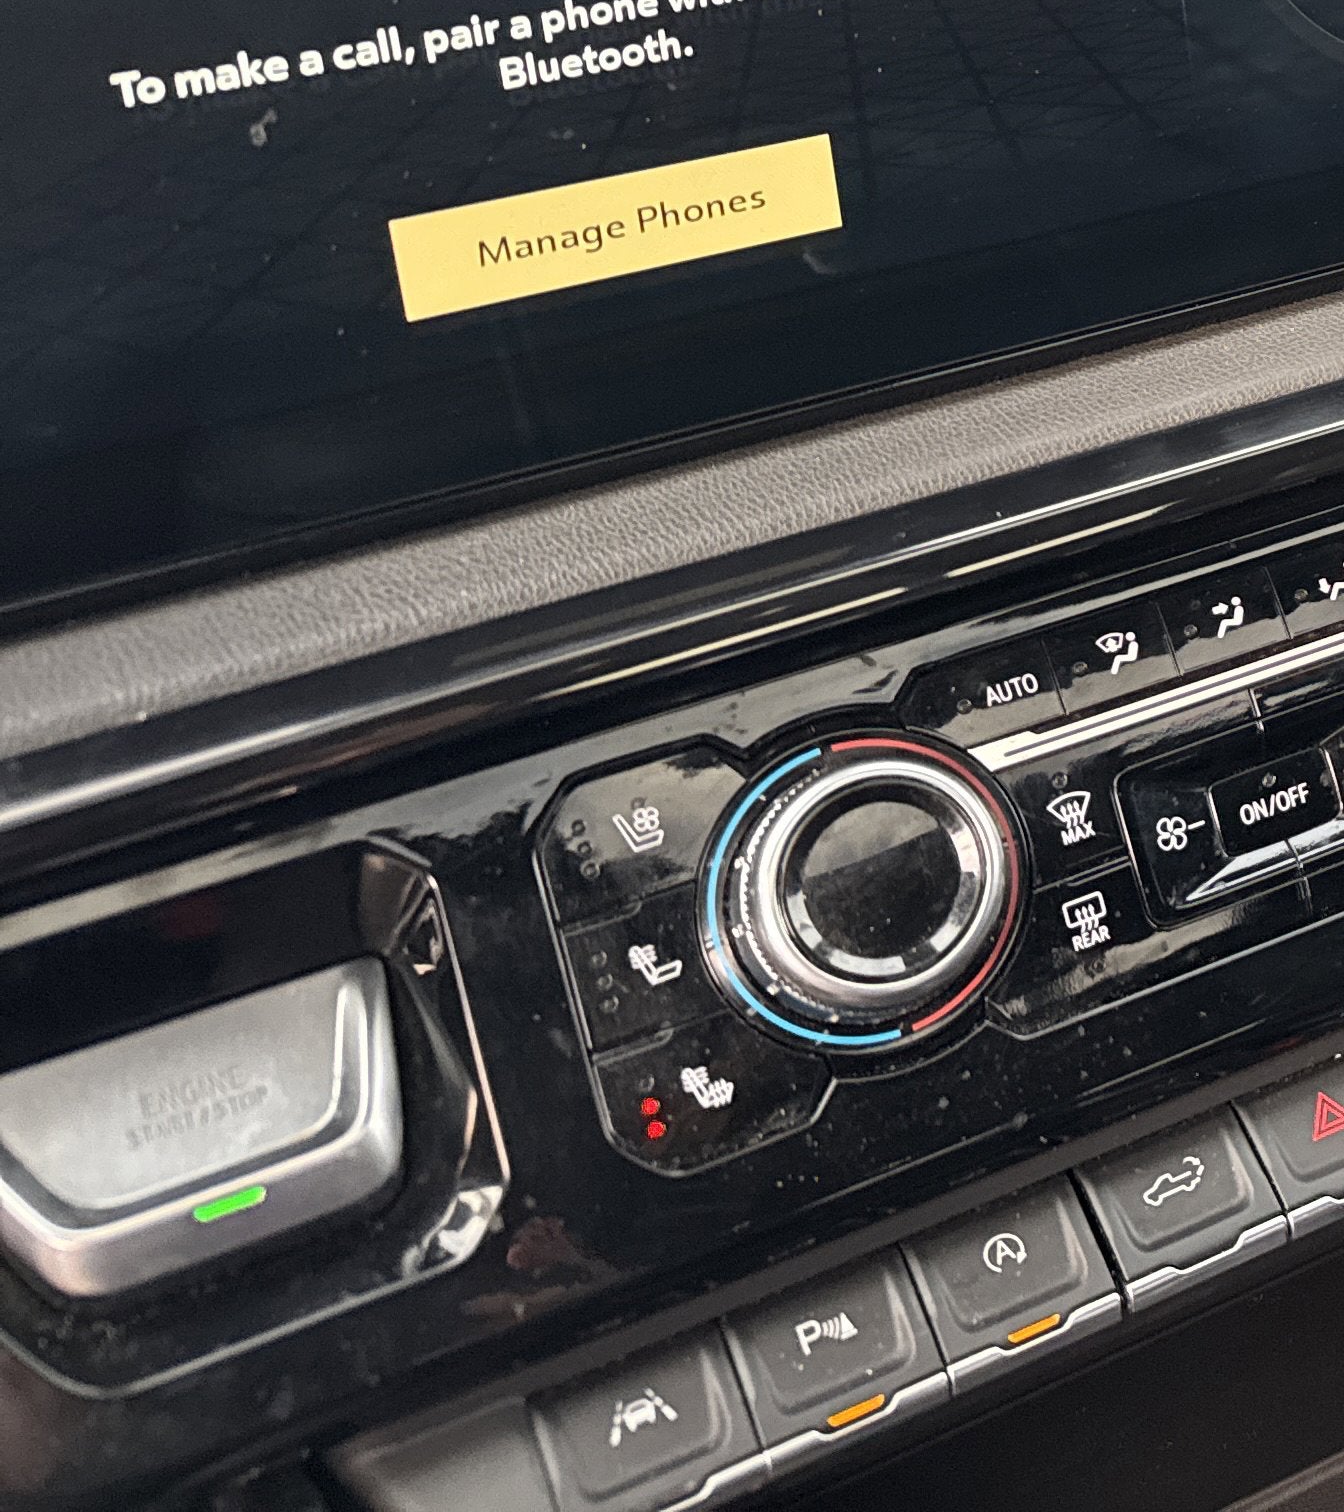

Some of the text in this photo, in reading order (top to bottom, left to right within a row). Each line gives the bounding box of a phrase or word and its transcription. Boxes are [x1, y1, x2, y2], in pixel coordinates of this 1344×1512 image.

[109, 69, 166, 108] To
[173, 50, 290, 99] make
[299, 49, 325, 77] a
[332, 25, 415, 70] call,
[422, 14, 501, 62] pair
[510, 15, 533, 40] a
[499, 33, 695, 90] Bluetooth.
[477, 185, 768, 269] Manage Phones
[986, 673, 1039, 707] AUTO
[1239, 783, 1310, 826] ON/OFF
[1060, 819, 1096, 846] MAX
[1070, 923, 1111, 952] REAR
